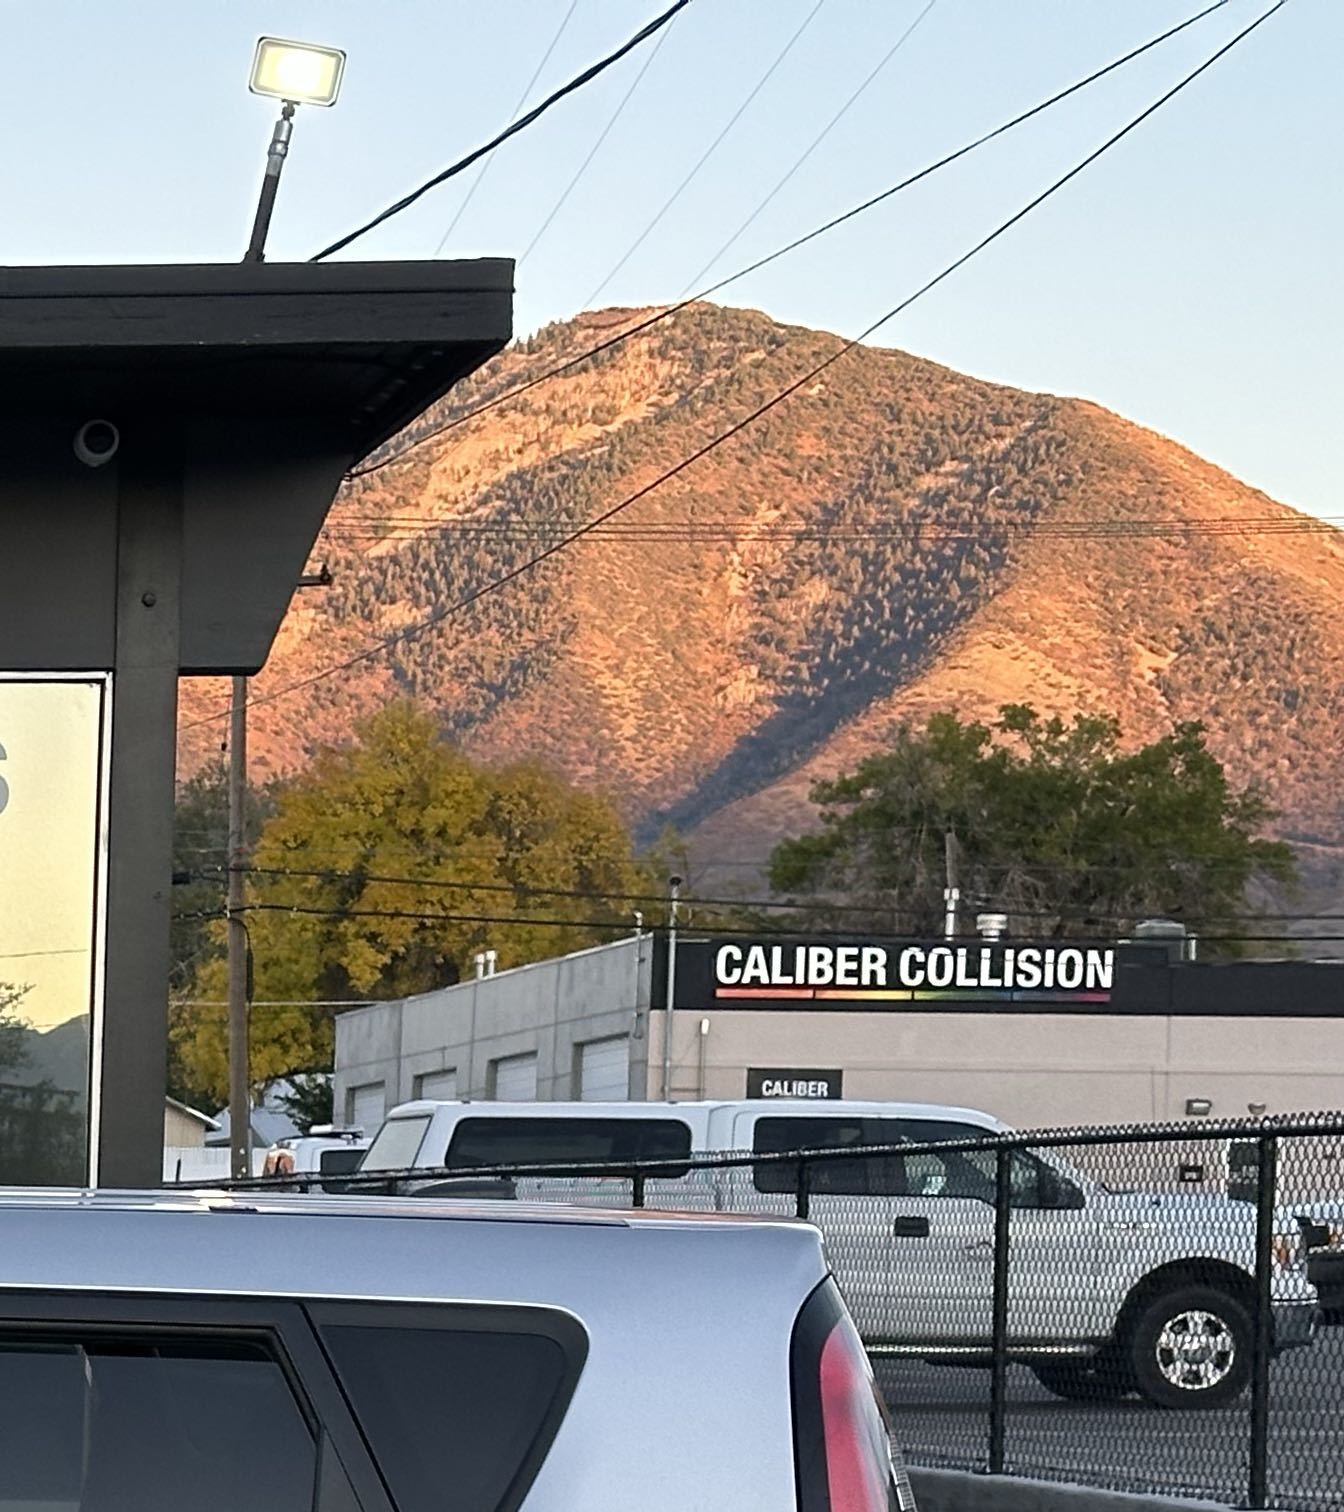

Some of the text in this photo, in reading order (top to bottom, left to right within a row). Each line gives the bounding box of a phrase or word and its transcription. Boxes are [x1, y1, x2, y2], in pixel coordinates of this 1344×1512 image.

[715, 944, 1114, 989] CALIBER COLLISION
[761, 1079, 829, 1098] CALIBER
